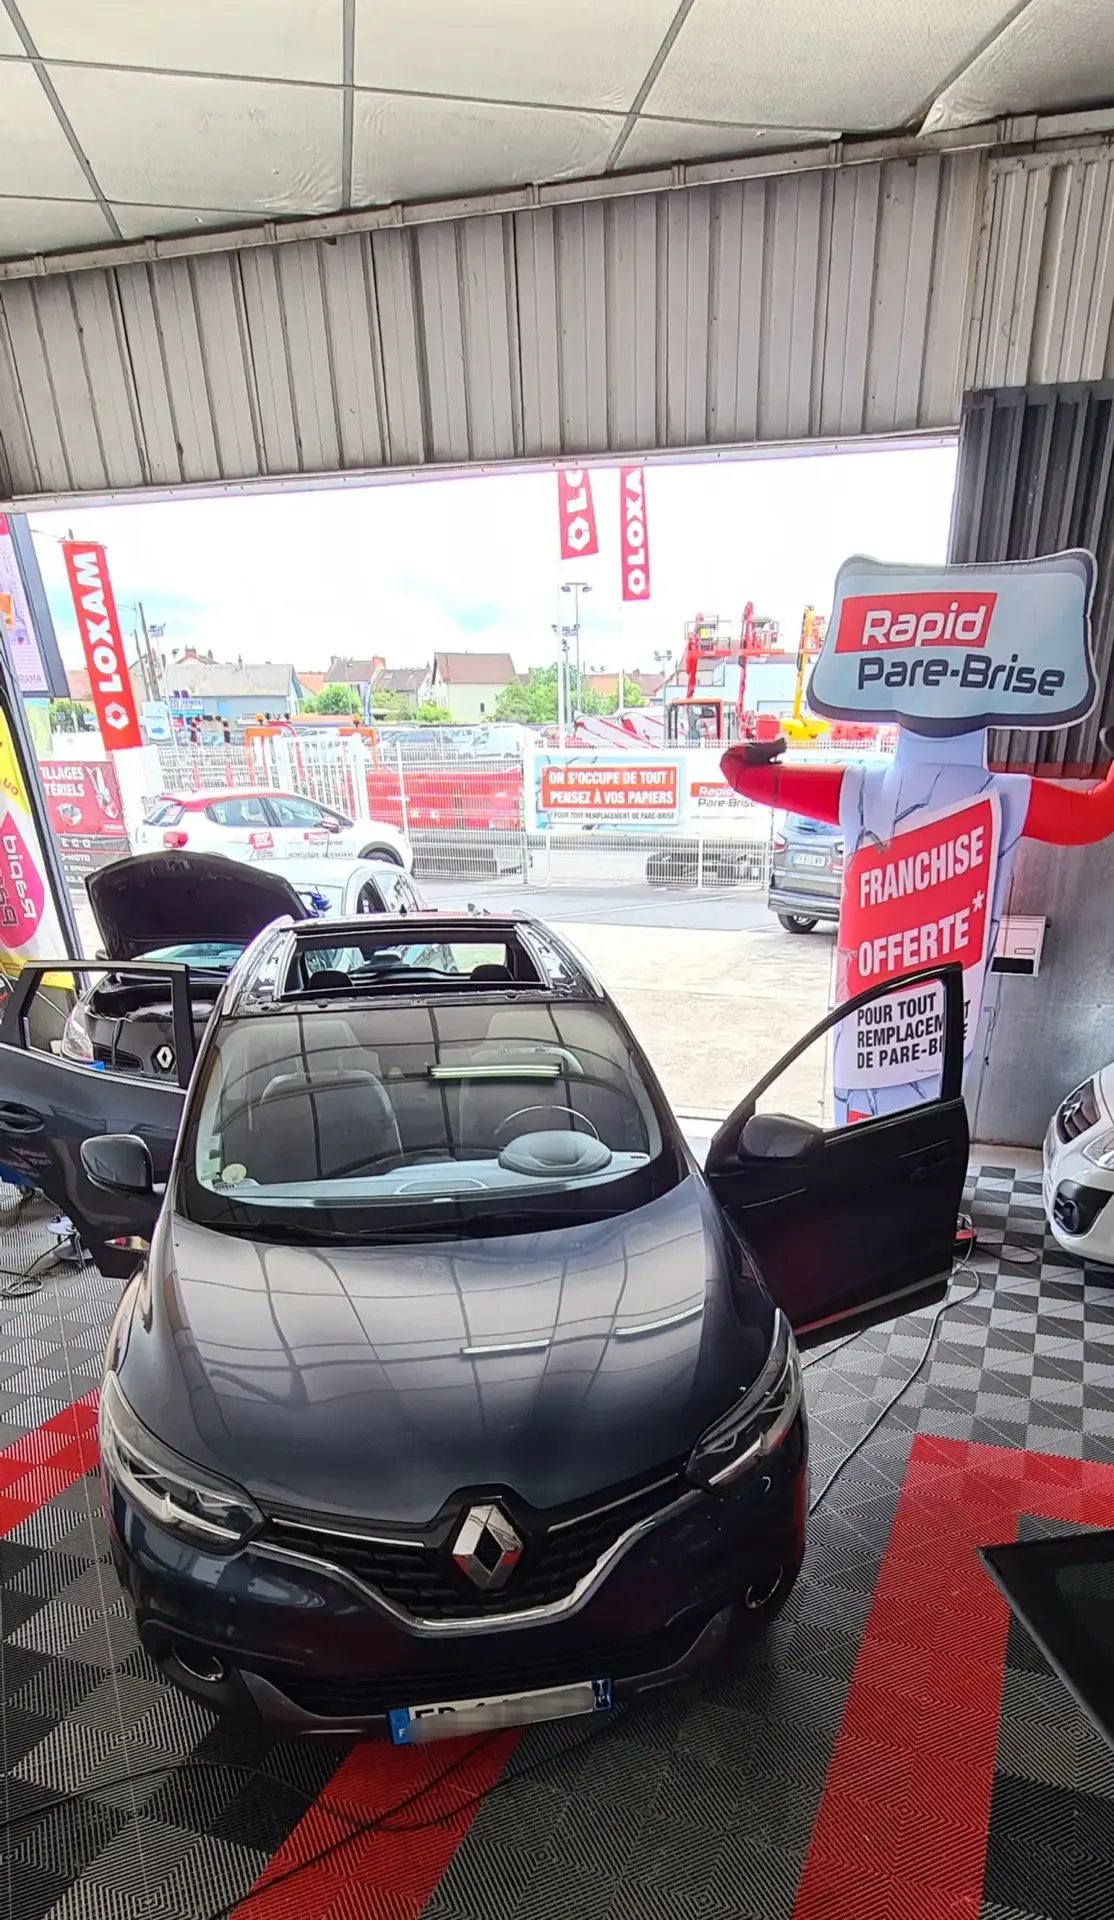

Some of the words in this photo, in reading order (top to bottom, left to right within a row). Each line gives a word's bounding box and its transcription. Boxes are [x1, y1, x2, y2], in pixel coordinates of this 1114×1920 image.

[72, 551, 124, 692] LOXAM
[861, 601, 987, 648] Rapid
[858, 653, 1066, 697] Pare-Brise
[549, 771, 565, 785] ON
[567, 771, 620, 785] S'OCCUPE
[623, 771, 638, 785] DE
[640, 771, 667, 785] TOUT
[549, 790, 592, 804] PENSEZ
[603, 790, 626, 804] VOS
[627, 790, 674, 804] PAPIERS
[860, 826, 984, 908] FRANCHISE
[857, 1004, 893, 1027] POUR
[897, 992, 937, 1020] TOUT
[857, 1051, 874, 1069] DE
